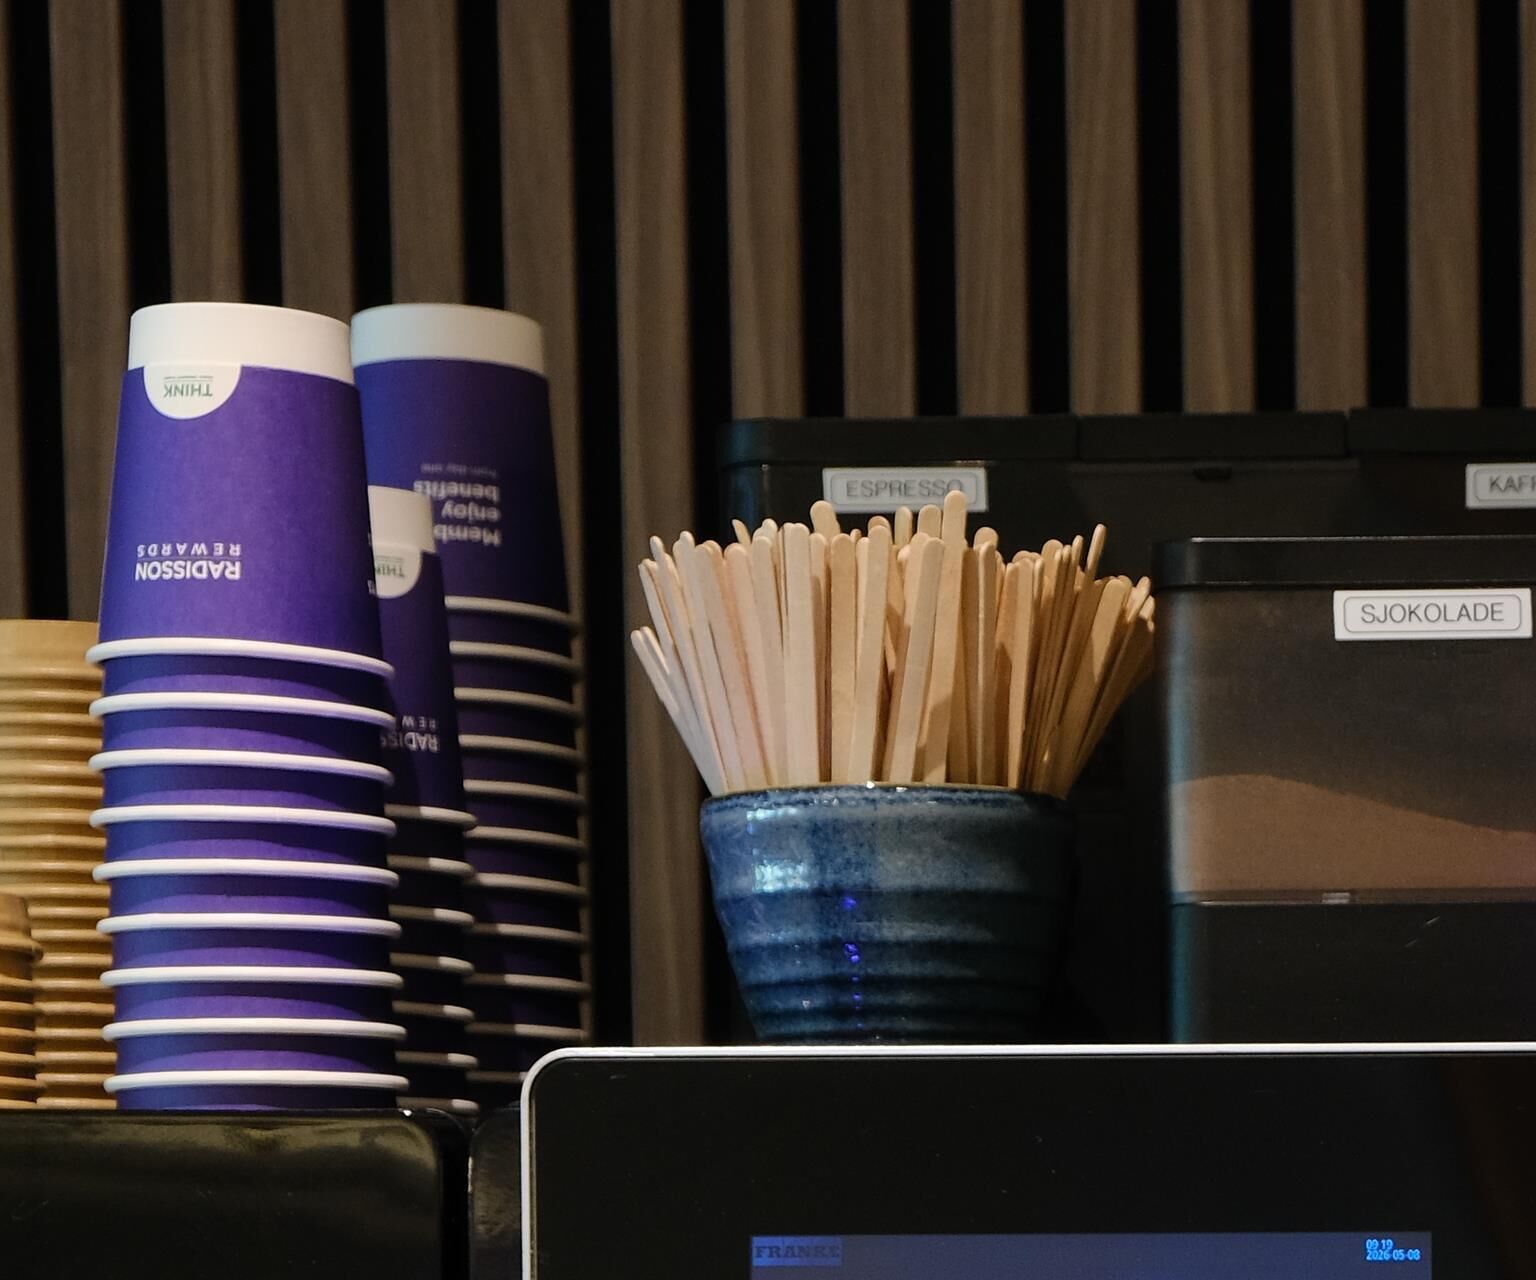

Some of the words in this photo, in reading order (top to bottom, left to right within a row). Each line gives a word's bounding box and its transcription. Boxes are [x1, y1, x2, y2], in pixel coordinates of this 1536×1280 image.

[163, 384, 213, 398] THINK
[413, 481, 500, 503] benefits
[846, 479, 963, 498] ESPRESSO
[441, 500, 501, 524] enjoy
[433, 525, 501, 547] Memb
[137, 543, 241, 557] REWARDS
[135, 561, 241, 581] RADISSON
[1361, 602, 1505, 624] SJOKOLADE
[756, 1246, 840, 1258] FRANKE
